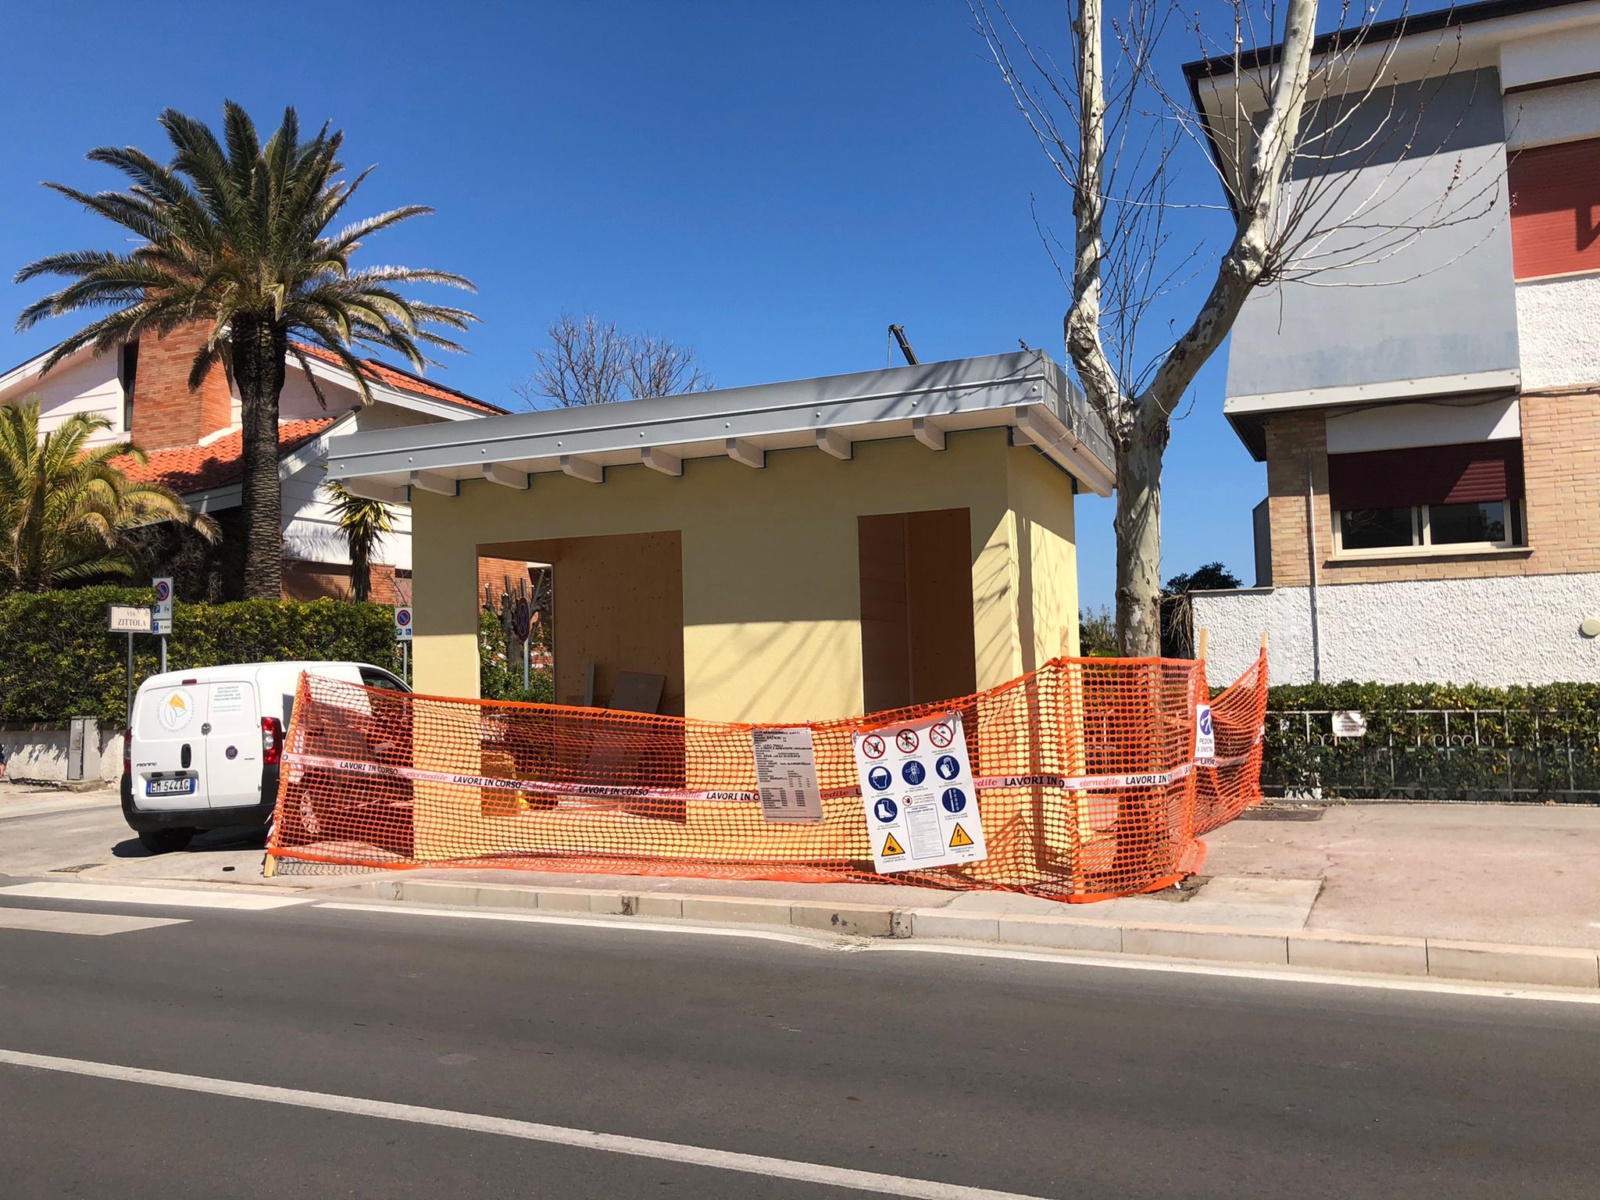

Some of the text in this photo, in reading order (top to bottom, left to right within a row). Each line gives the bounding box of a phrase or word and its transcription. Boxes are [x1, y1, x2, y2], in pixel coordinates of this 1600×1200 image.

[117, 619, 146, 627] ZITTOLA
[151, 780, 189, 792] EM 544AG
[340, 761, 366, 771] LAVORI
[368, 764, 377, 772] IN
[378, 766, 399, 775] CORSO
[406, 771, 449, 781] eternedile
[453, 775, 482, 786] LAVORI
[484, 779, 494, 787] IN
[495, 779, 522, 789] CORSO
[579, 786, 607, 796] LAVORI
[608, 788, 620, 796] IN
[621, 788, 649, 796] CORSO
[706, 792, 738, 801] LAVORI
[740, 793, 751, 801] IN
[1004, 777, 1044, 787] LAVORI
[1046, 776, 1058, 786] IN
[1079, 777, 1120, 787] eternedile
[1125, 775, 1156, 785] LAVORI
[1158, 774, 1167, 783] IN
